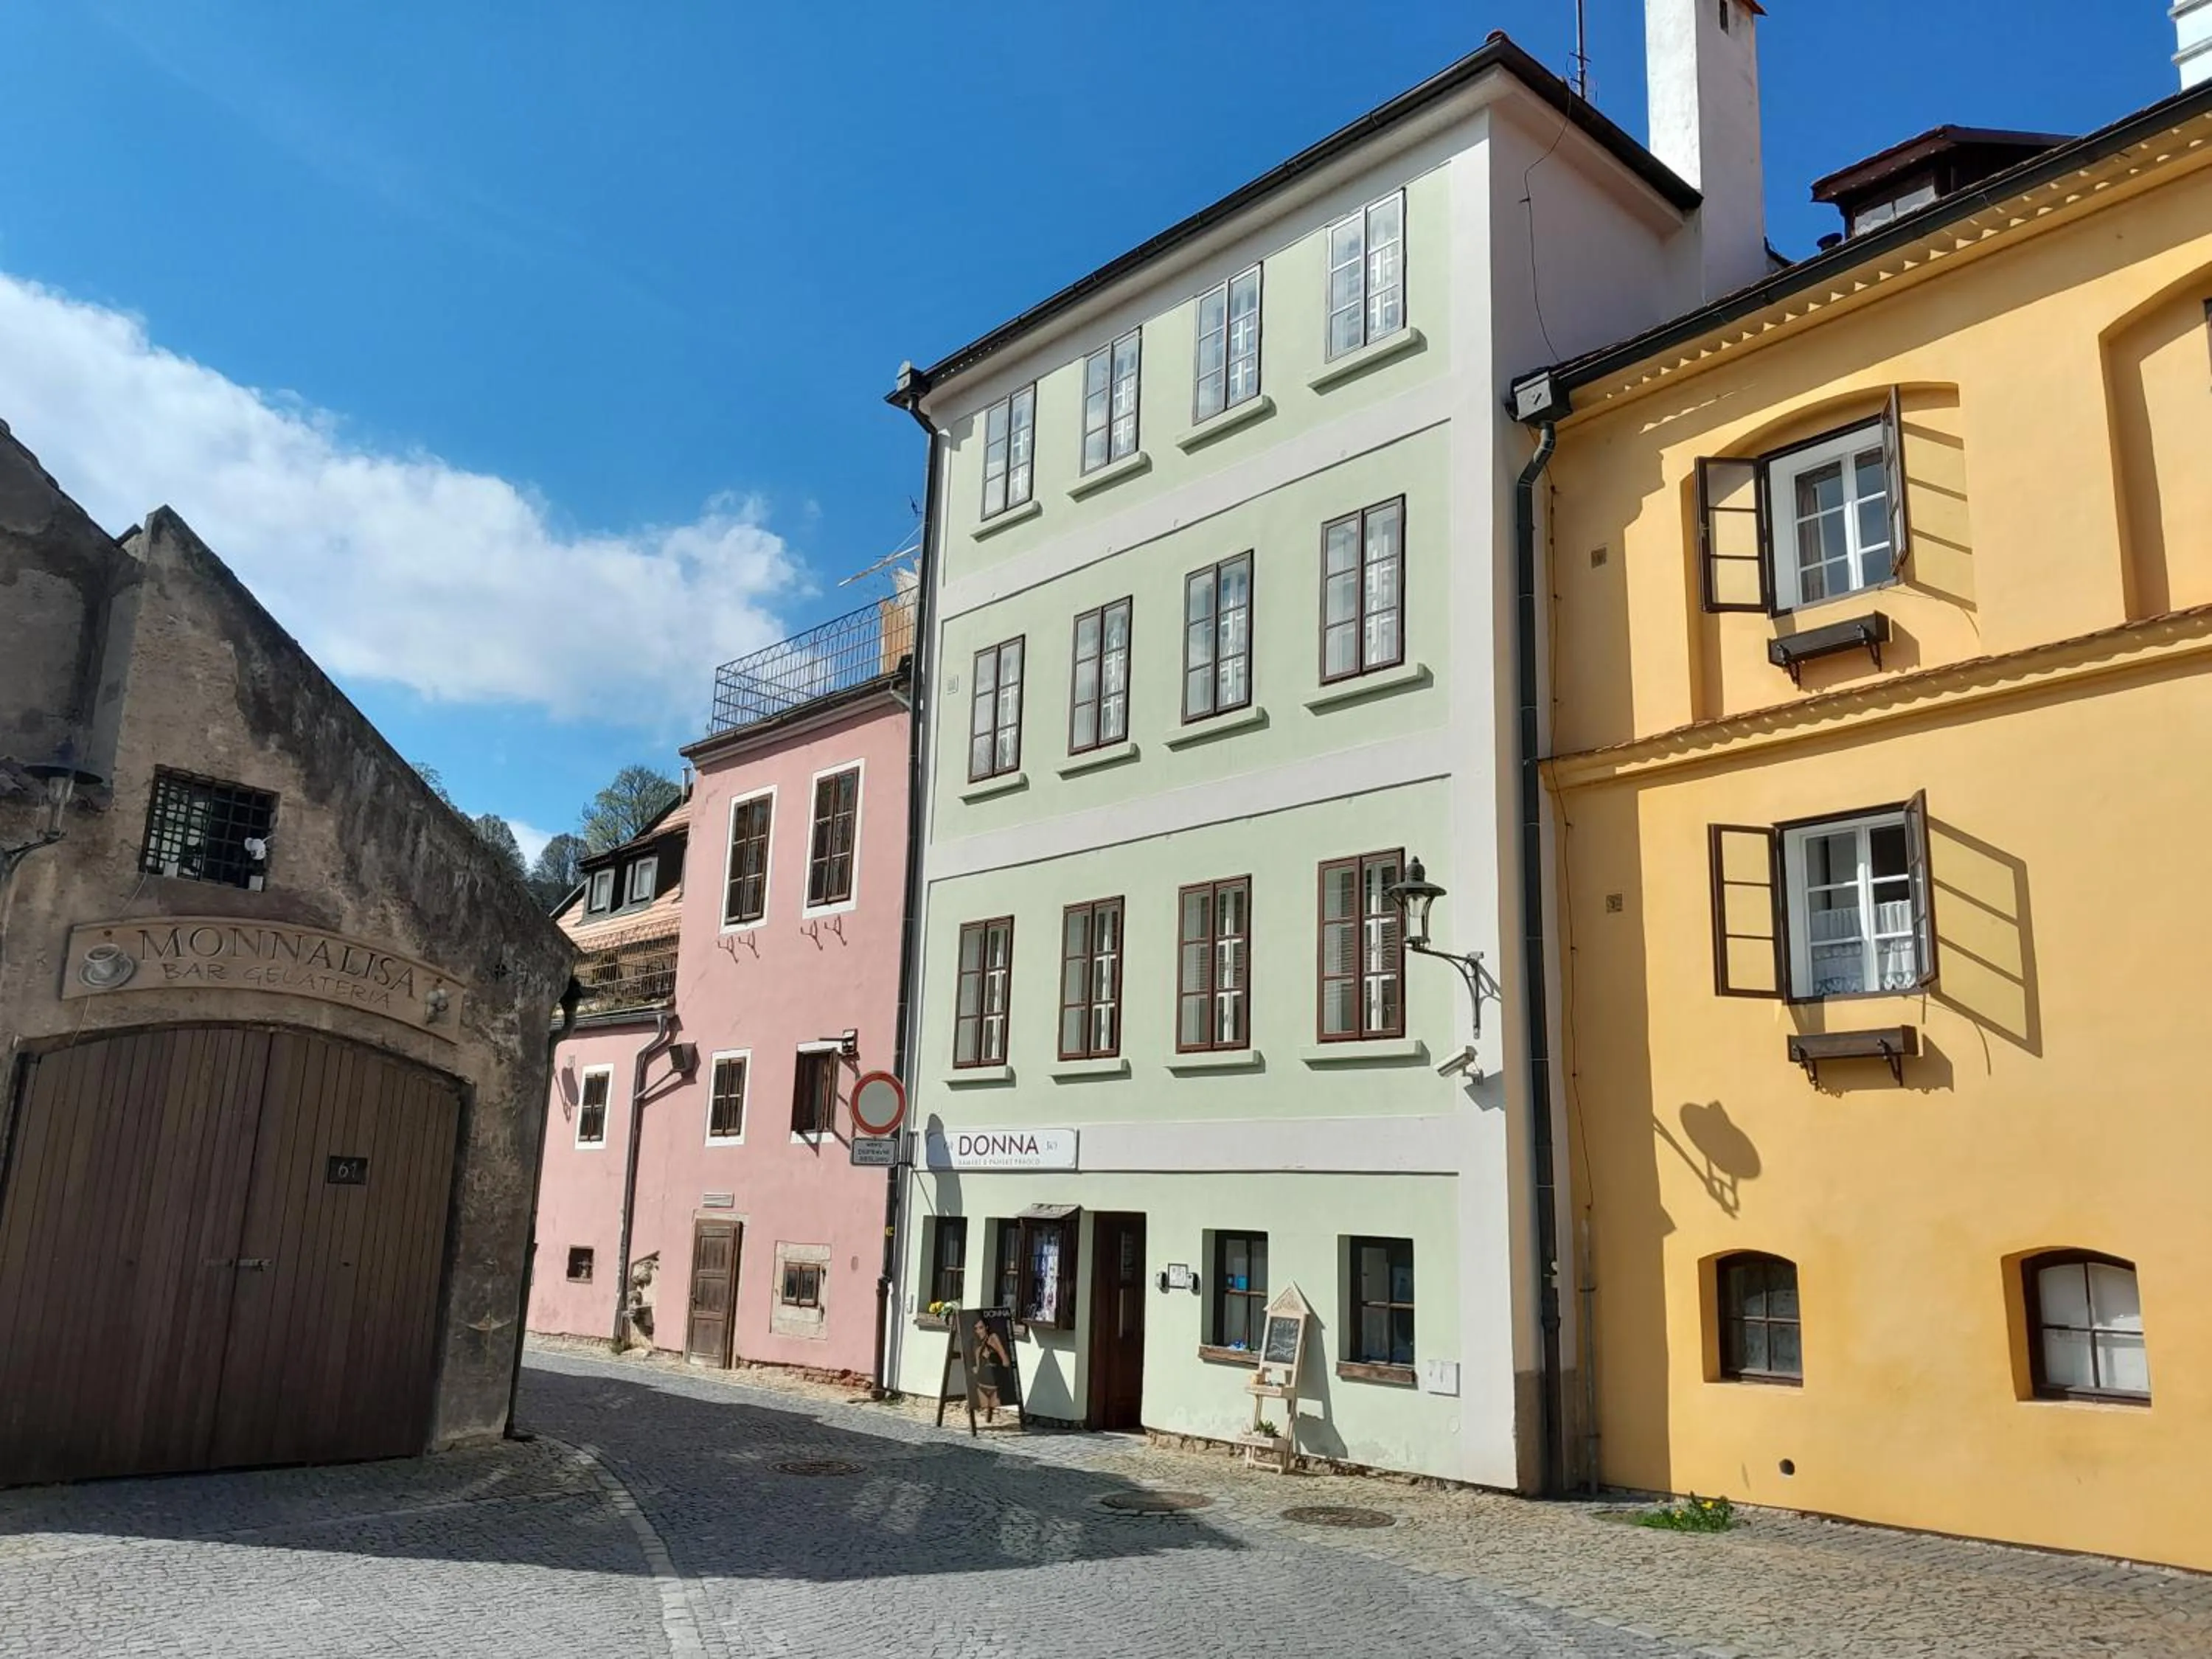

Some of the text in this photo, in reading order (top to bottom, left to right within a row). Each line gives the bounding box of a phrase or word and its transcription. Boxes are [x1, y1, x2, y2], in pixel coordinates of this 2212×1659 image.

[137, 926, 417, 998] MONNALISA
[162, 961, 391, 1009] BAR GELATERIA
[959, 1135, 1039, 1155] DONNA
[338, 1162, 357, 1178] 61
